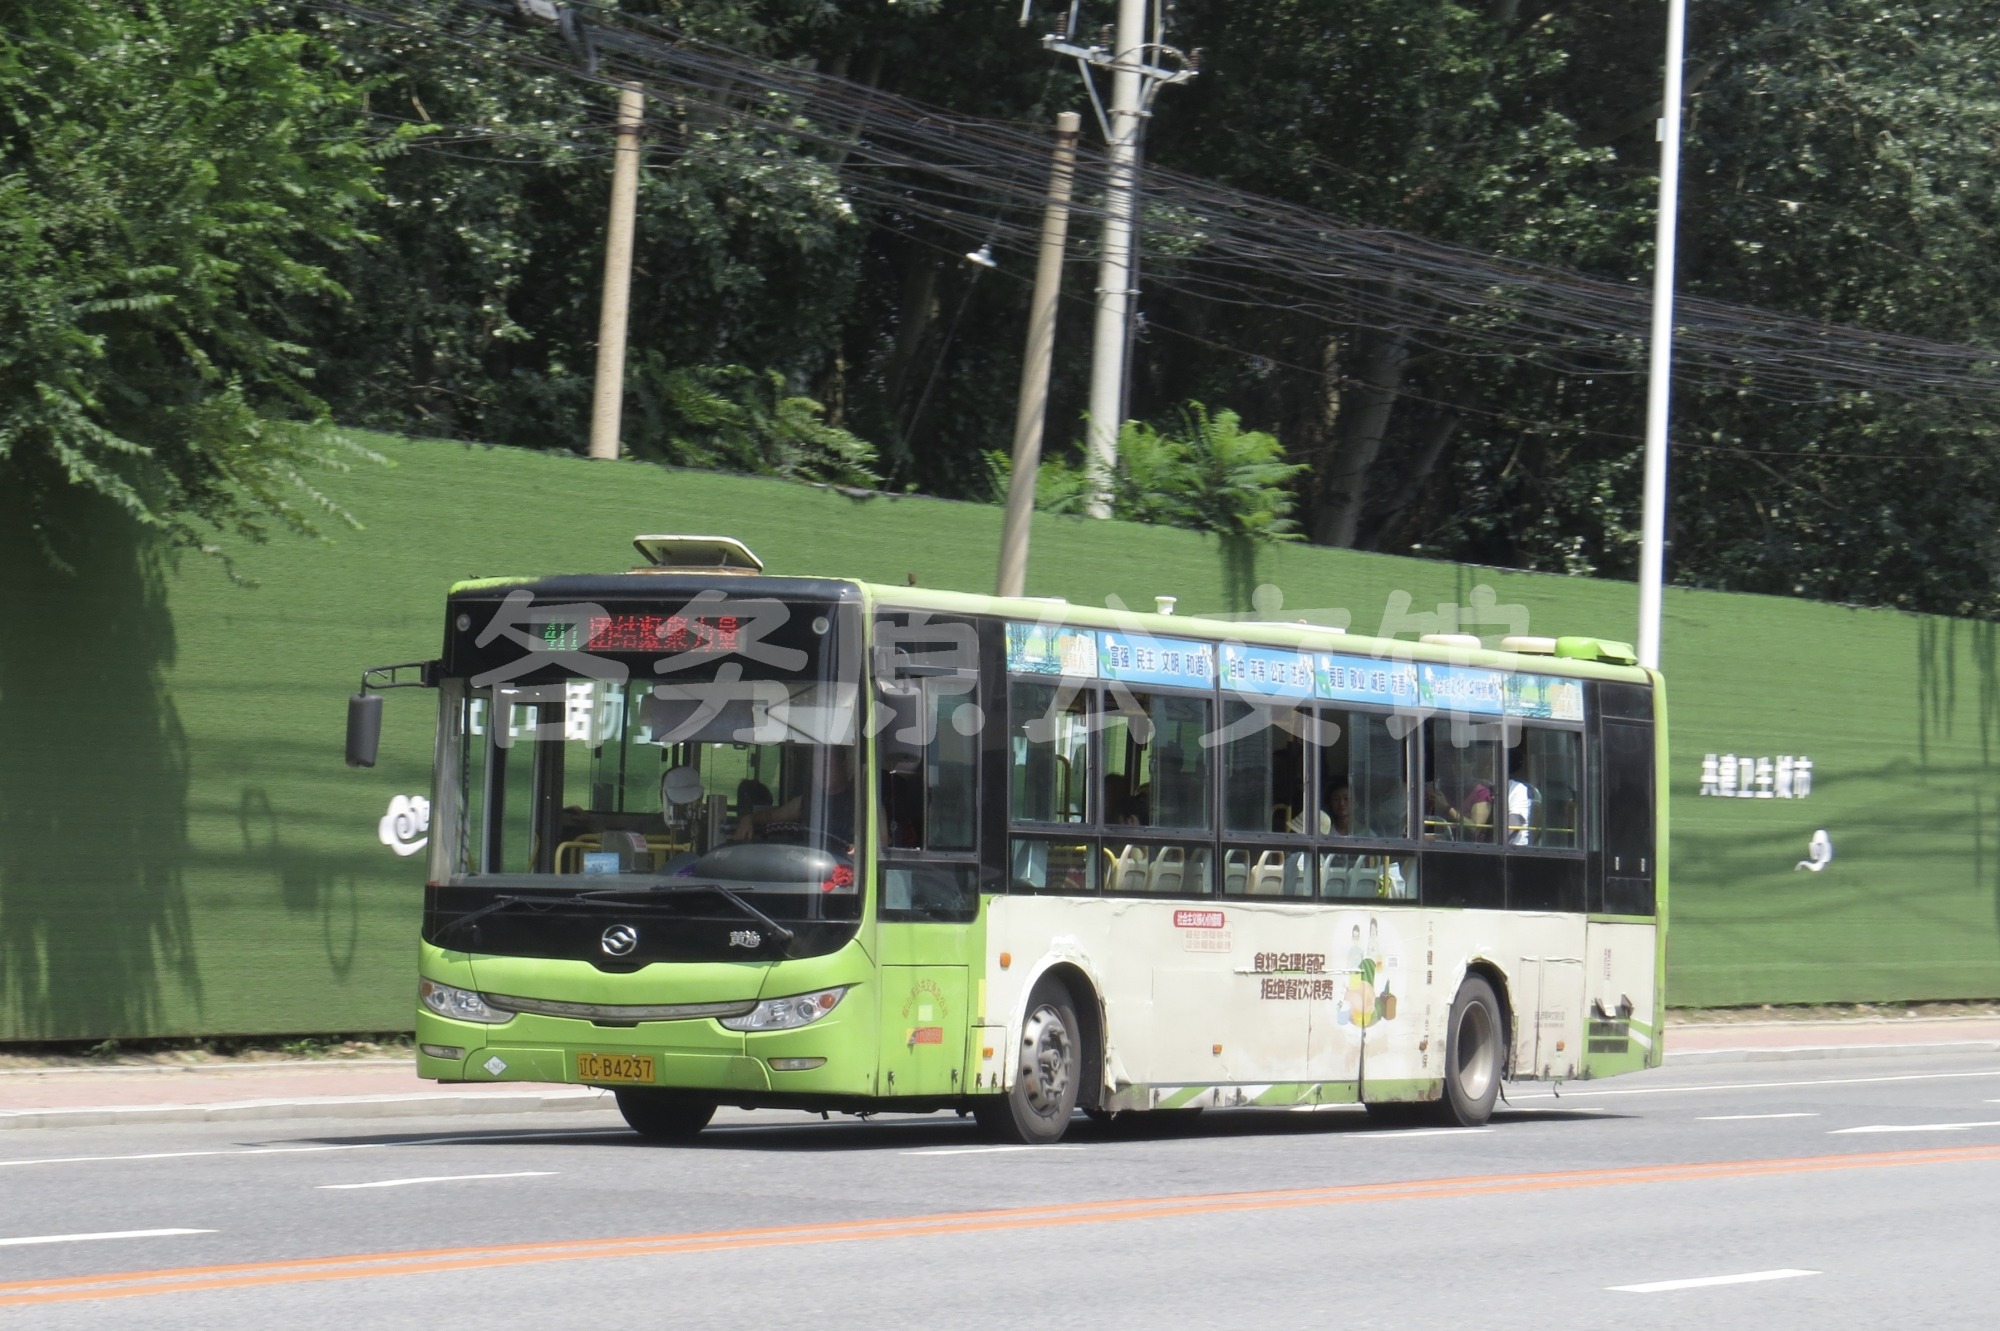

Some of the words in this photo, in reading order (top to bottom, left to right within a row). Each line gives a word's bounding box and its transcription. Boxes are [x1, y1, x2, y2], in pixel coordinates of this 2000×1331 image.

[1110, 645, 1130, 669] 富强
[1136, 648, 1155, 671] 民主
[1161, 651, 1180, 673] 文明
[1186, 654, 1205, 677] 和谐
[1230, 658, 1245, 679] 自由
[1250, 659, 1265, 681] 平等
[1270, 661, 1286, 684] 公正
[1329, 667, 1345, 688] 爱国
[1350, 668, 1365, 690] 敬业
[1370, 671, 1386, 693] 诚信
[1391, 674, 1406, 695] 友善
[729, 930, 761, 949] 黄海
[1254, 952, 1326, 973] 食物合理搭配
[1260, 978, 1333, 1001] 拒绝餐饮浪费
